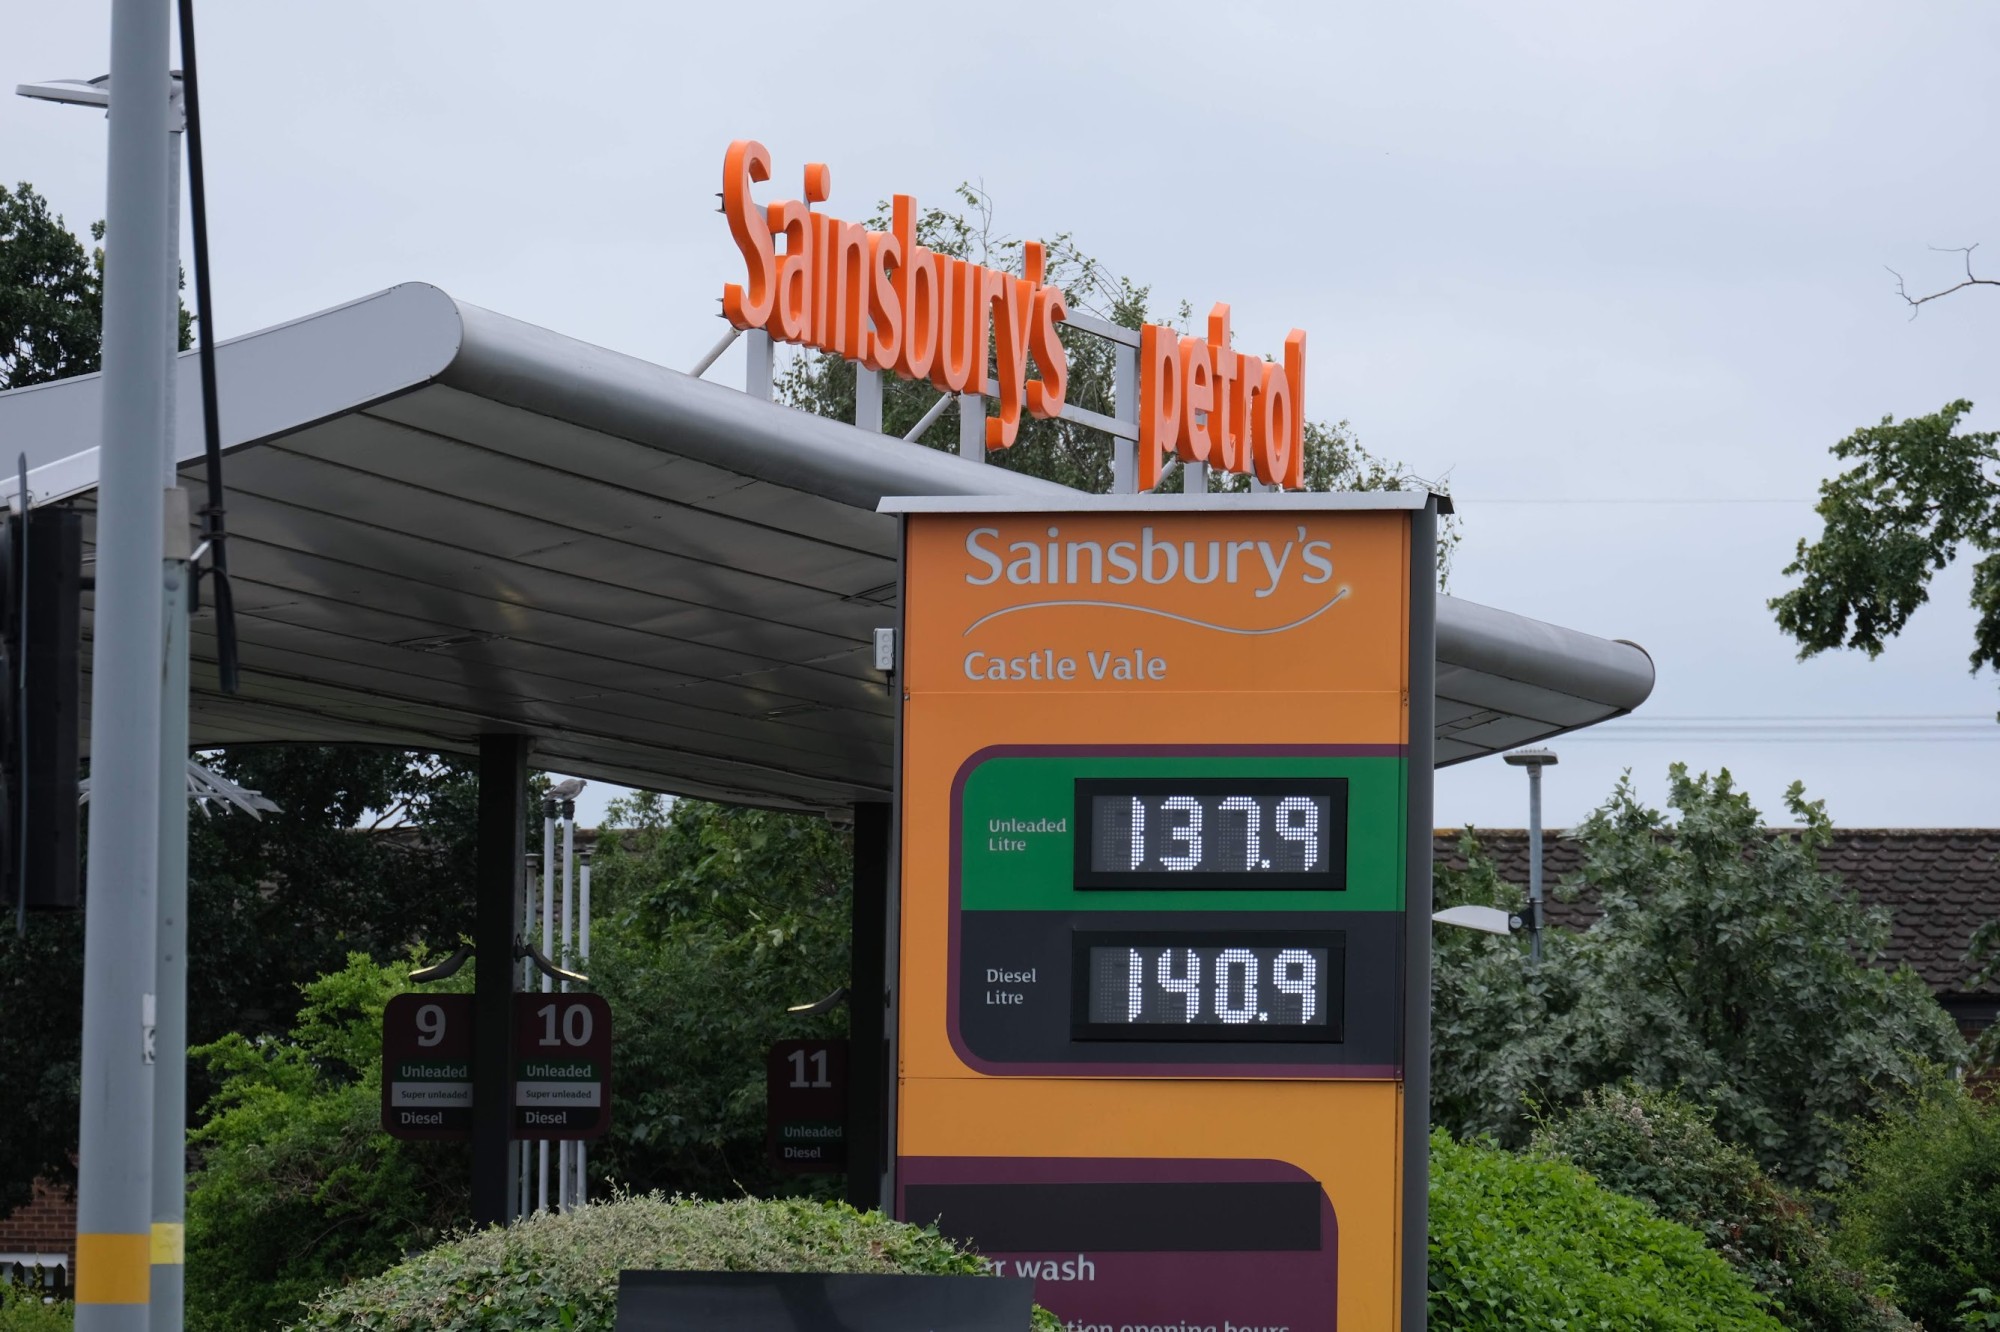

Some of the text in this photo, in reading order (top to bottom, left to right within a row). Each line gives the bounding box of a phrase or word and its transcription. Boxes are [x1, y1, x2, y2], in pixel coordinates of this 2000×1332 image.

[722, 140, 1307, 491] Sainsbury's petrol
[965, 526, 1333, 598] Sainsbury's
[963, 648, 1167, 681] Castle Vale
[989, 818, 1067, 832] Unleaded
[1131, 796, 1319, 872] 137.9
[989, 837, 1026, 851] Litre
[986, 968, 1037, 983] Diesel
[1127, 948, 1317, 1024] 140.9
[986, 990, 1024, 1005] Litre
[415, 1004, 446, 1047] 9
[537, 1004, 593, 1047] 10
[402, 1065, 468, 1078] Unleaded
[526, 1065, 592, 1077] Unleaded
[787, 1049, 832, 1088] 11
[401, 1090, 468, 1100] Super unleaded
[526, 1090, 592, 1099] Super unleaded
[401, 1112, 443, 1125] Diesel
[525, 1112, 567, 1125] Diesel
[784, 1126, 843, 1138] Unleaded
[784, 1147, 821, 1159] Diesel
[1015, 1253, 1095, 1281] wash
